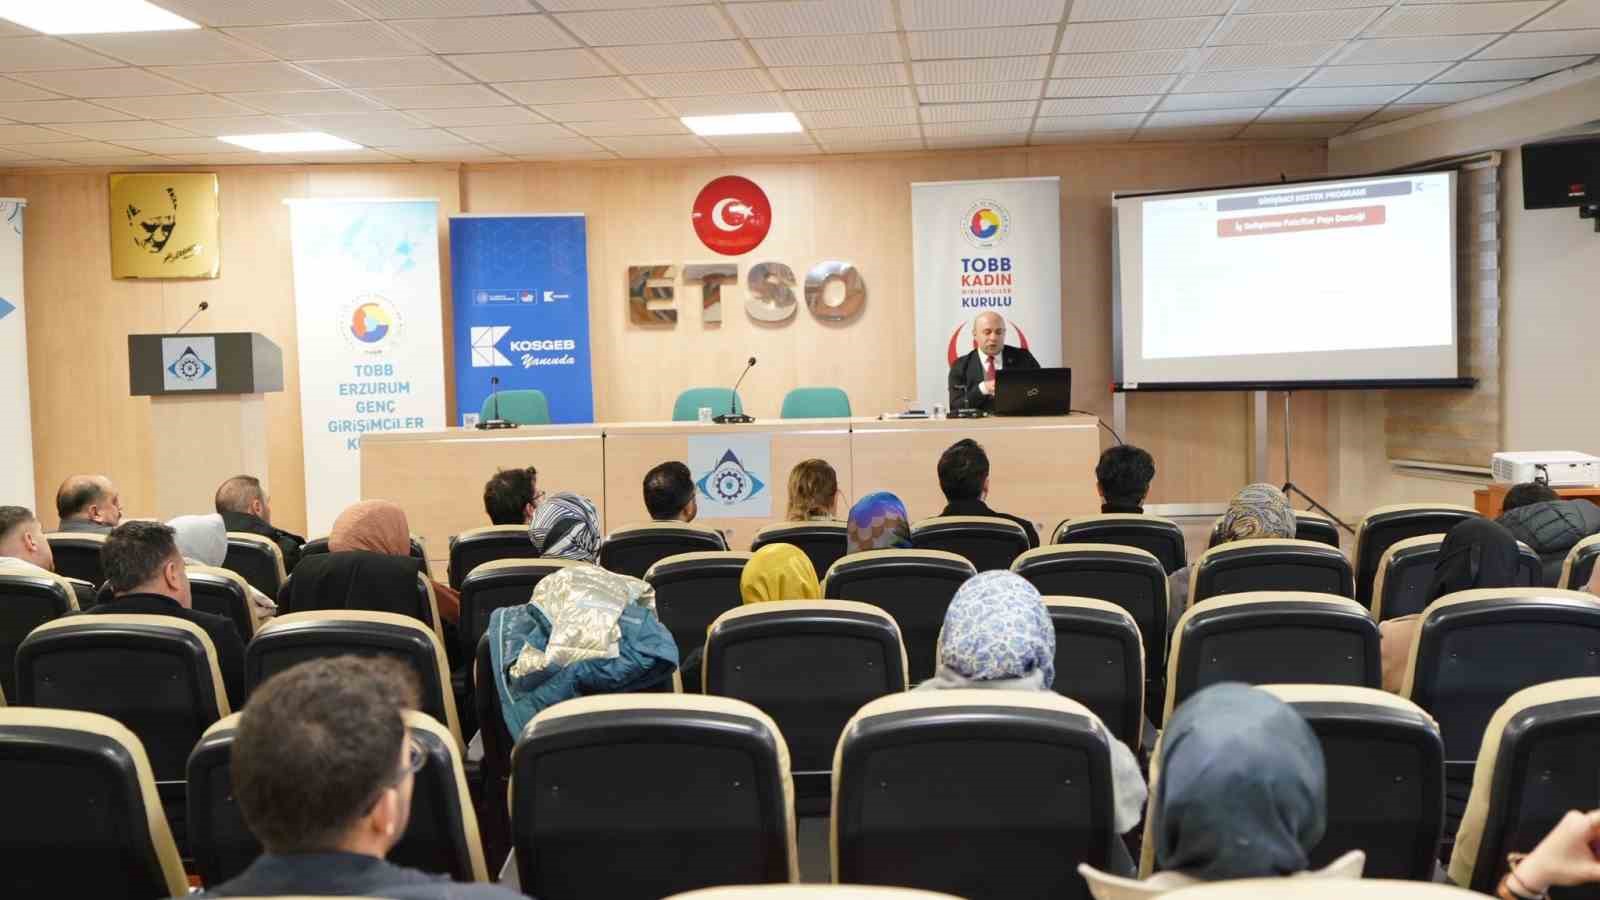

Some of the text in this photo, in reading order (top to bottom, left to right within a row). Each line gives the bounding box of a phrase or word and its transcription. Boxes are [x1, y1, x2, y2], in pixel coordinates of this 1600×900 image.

[961, 257, 1012, 272] TOBB
[961, 273, 1012, 287] KADIN
[627, 260, 867, 328] ETSO
[961, 296, 1012, 308] KURULU
[510, 339, 576, 351] KOSGEB
[521, 353, 576, 368] Yanında
[354, 364, 394, 377] TOBB
[338, 382, 411, 396] ERZURUM
[356, 400, 396, 413] GENÇ
